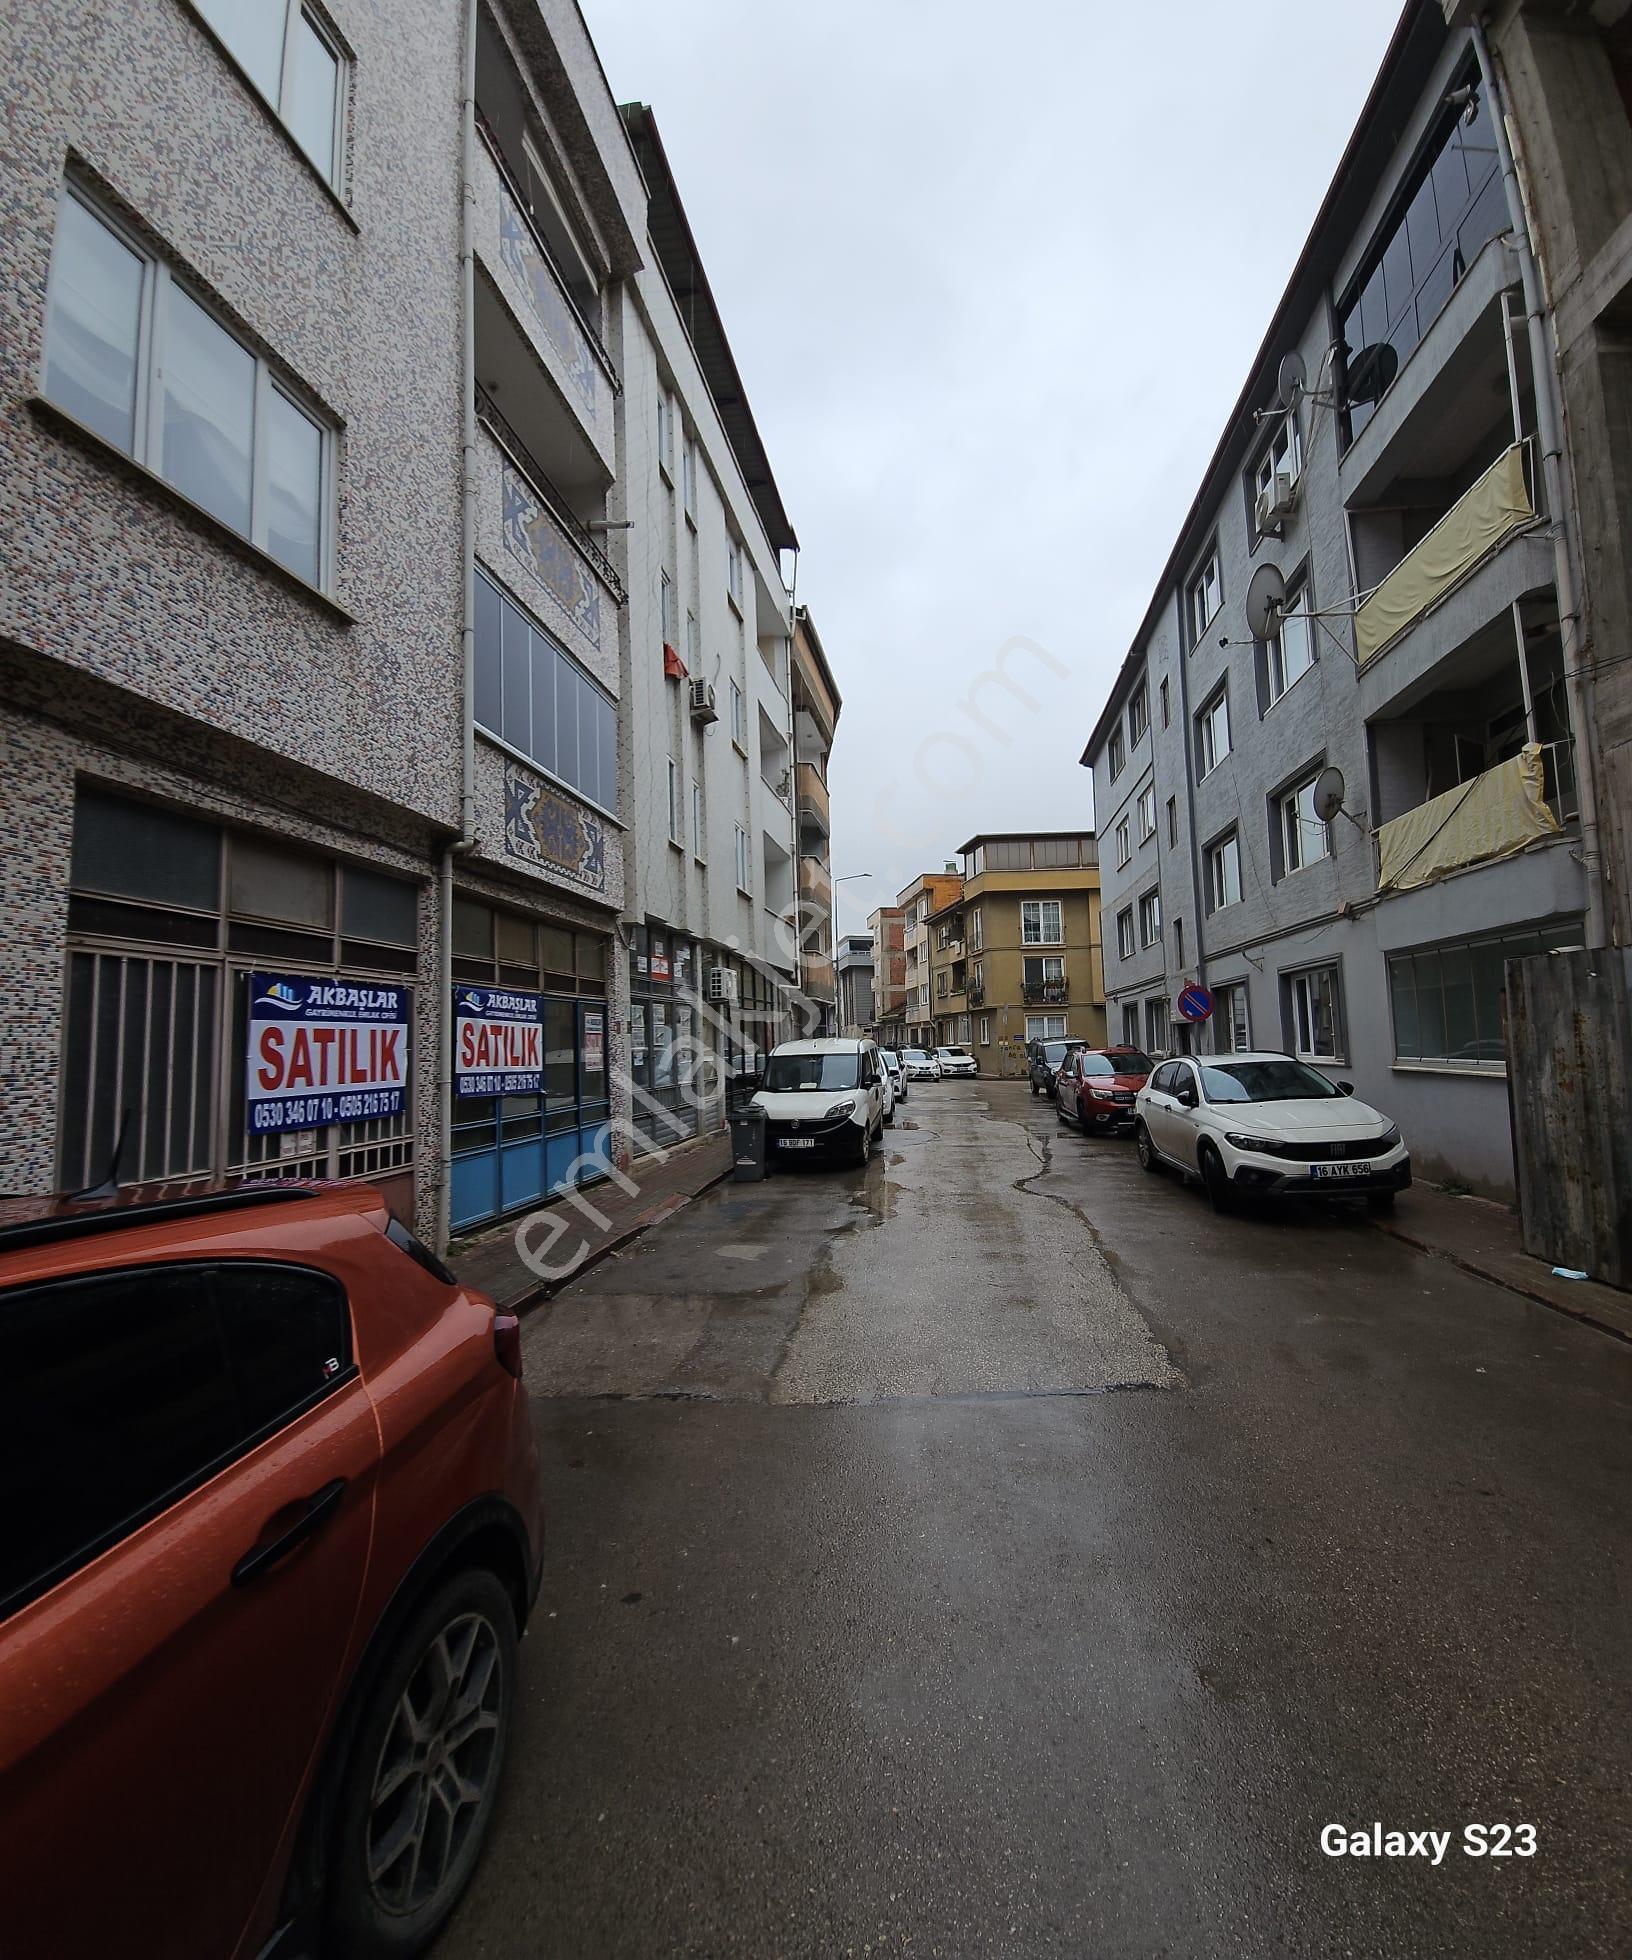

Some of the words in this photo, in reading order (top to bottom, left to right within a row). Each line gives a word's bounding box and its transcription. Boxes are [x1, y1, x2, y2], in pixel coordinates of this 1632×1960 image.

[306, 985, 398, 1010] AKBAŞLAR
[257, 1026, 401, 1090] SATILIK
[461, 1022, 540, 1068] SATILIK
[254, 1103, 284, 1128] 0530
[285, 1100, 305, 1125] 346
[306, 1099, 320, 1122] 07
[321, 1097, 333, 1120] 10
[1317, 1166, 1329, 1177] 16
[1331, 1165, 1350, 1176] AYK
[1351, 1163, 1369, 1175] 656
